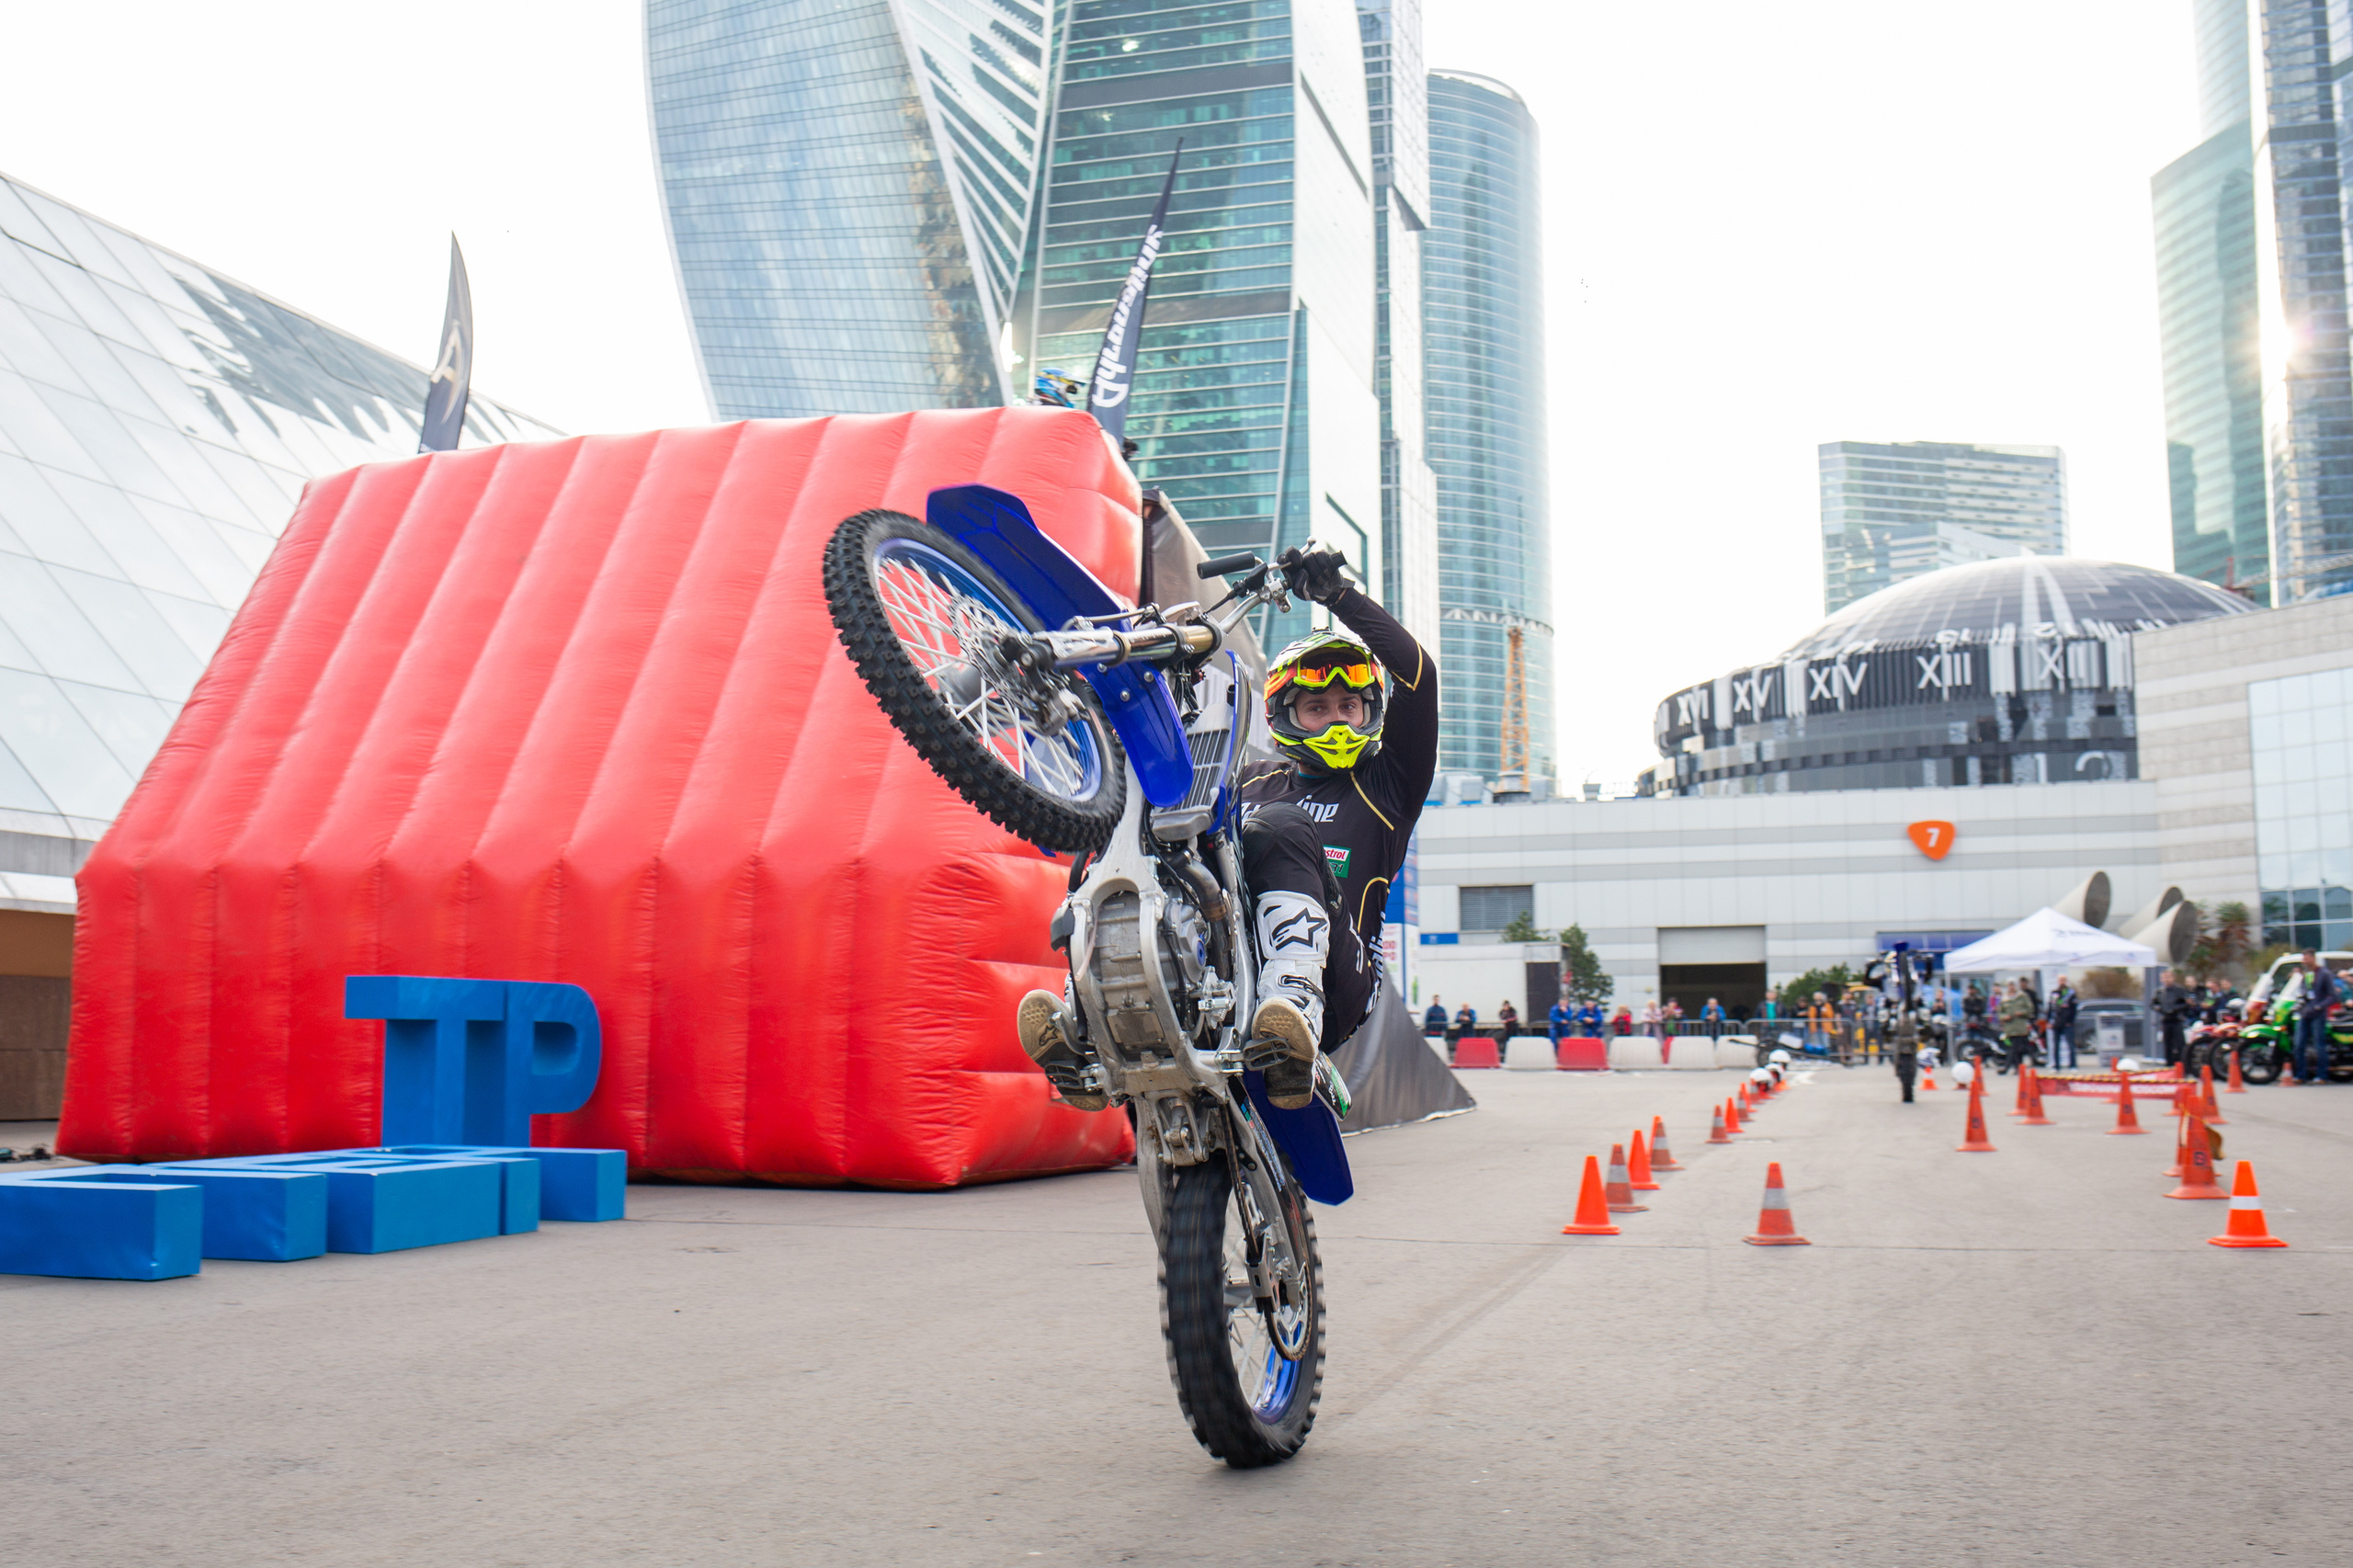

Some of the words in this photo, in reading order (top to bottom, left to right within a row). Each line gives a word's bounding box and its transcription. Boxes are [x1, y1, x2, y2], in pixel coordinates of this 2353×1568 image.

[1808, 661, 1868, 701] XIV
[1916, 652, 1972, 689] XIII
[1926, 827, 1940, 847] 7
[1324, 848, 1346, 860] strol
